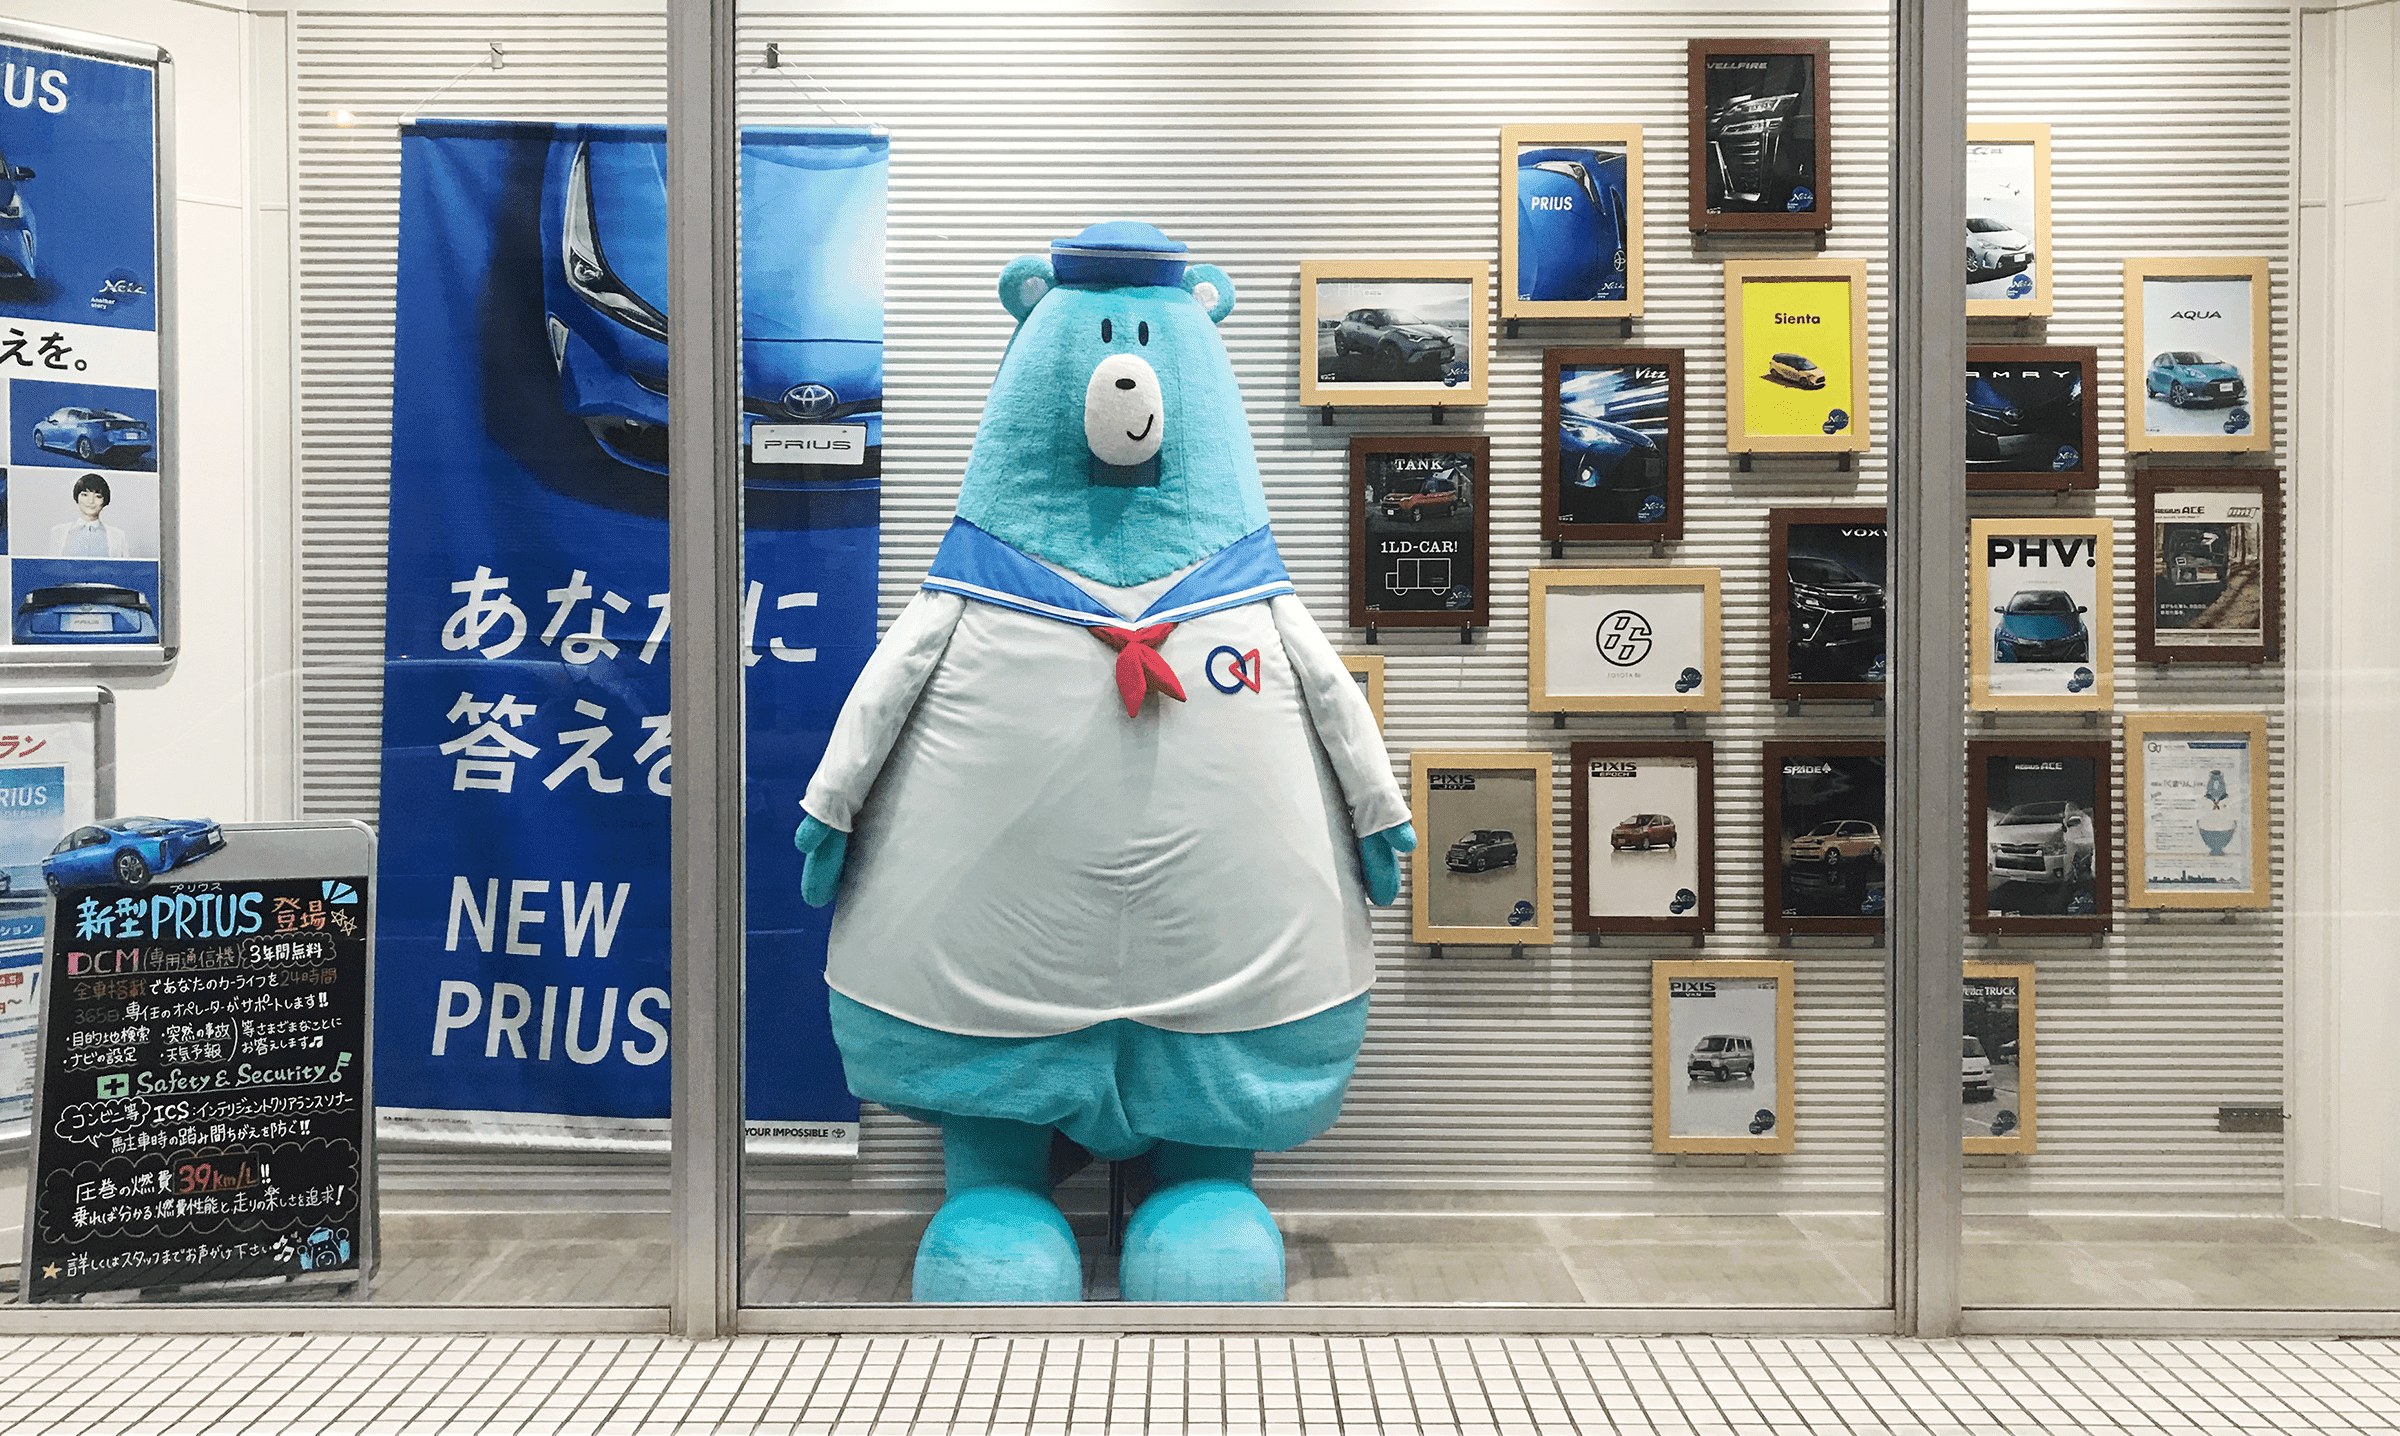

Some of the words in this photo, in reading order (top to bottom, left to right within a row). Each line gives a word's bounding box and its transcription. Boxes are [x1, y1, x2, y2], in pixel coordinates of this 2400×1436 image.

[1706, 62, 1768, 70] VELLFIRE
[1531, 196, 1573, 210] PRIUS
[1774, 312, 1821, 324] Sienta
[2170, 310, 2222, 320] AQUA
[1635, 367, 1667, 380] Vitz
[764, 440, 851, 450] PRIUS
[1394, 459, 1443, 471] TANK
[1380, 540, 1458, 553] 1LD-CAR!
[1987, 538, 2096, 568] PHV!
[1591, 761, 1637, 771] PIXIS
[1430, 774, 1475, 784] PIXIS
[169, 882, 224, 894] プリウス
[444, 875, 631, 958] NEW
[1670, 982, 1716, 991] PIXIS
[1984, 986, 2017, 996] TRUCK
[431, 979, 671, 1067] PRIUS
[136, 1068, 210, 1095] Safety
[214, 1069, 230, 1087] &
[235, 1063, 326, 1087] Security
[72, 1102, 140, 1129] コンビニ等
[773, 1128, 829, 1137] IMPOSSIBLE
